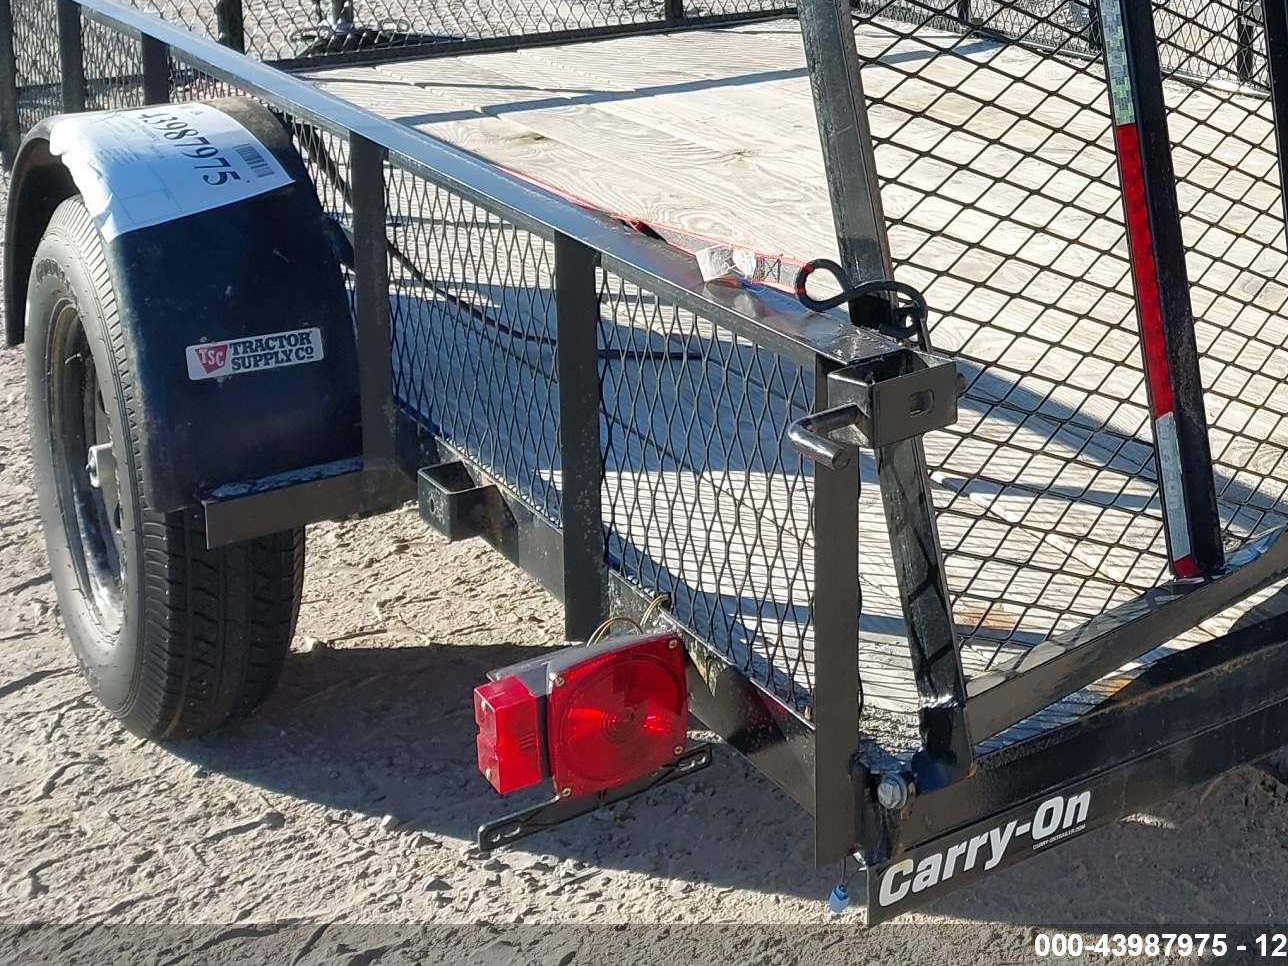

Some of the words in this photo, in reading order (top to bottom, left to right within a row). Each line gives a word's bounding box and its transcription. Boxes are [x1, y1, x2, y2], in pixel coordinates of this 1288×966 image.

[141, 113, 240, 186] 43987975
[230, 332, 312, 356] TRACTOR
[197, 347, 225, 366] TSC
[231, 349, 294, 371] SUPPLY
[878, 791, 1091, 907] Carry-On
